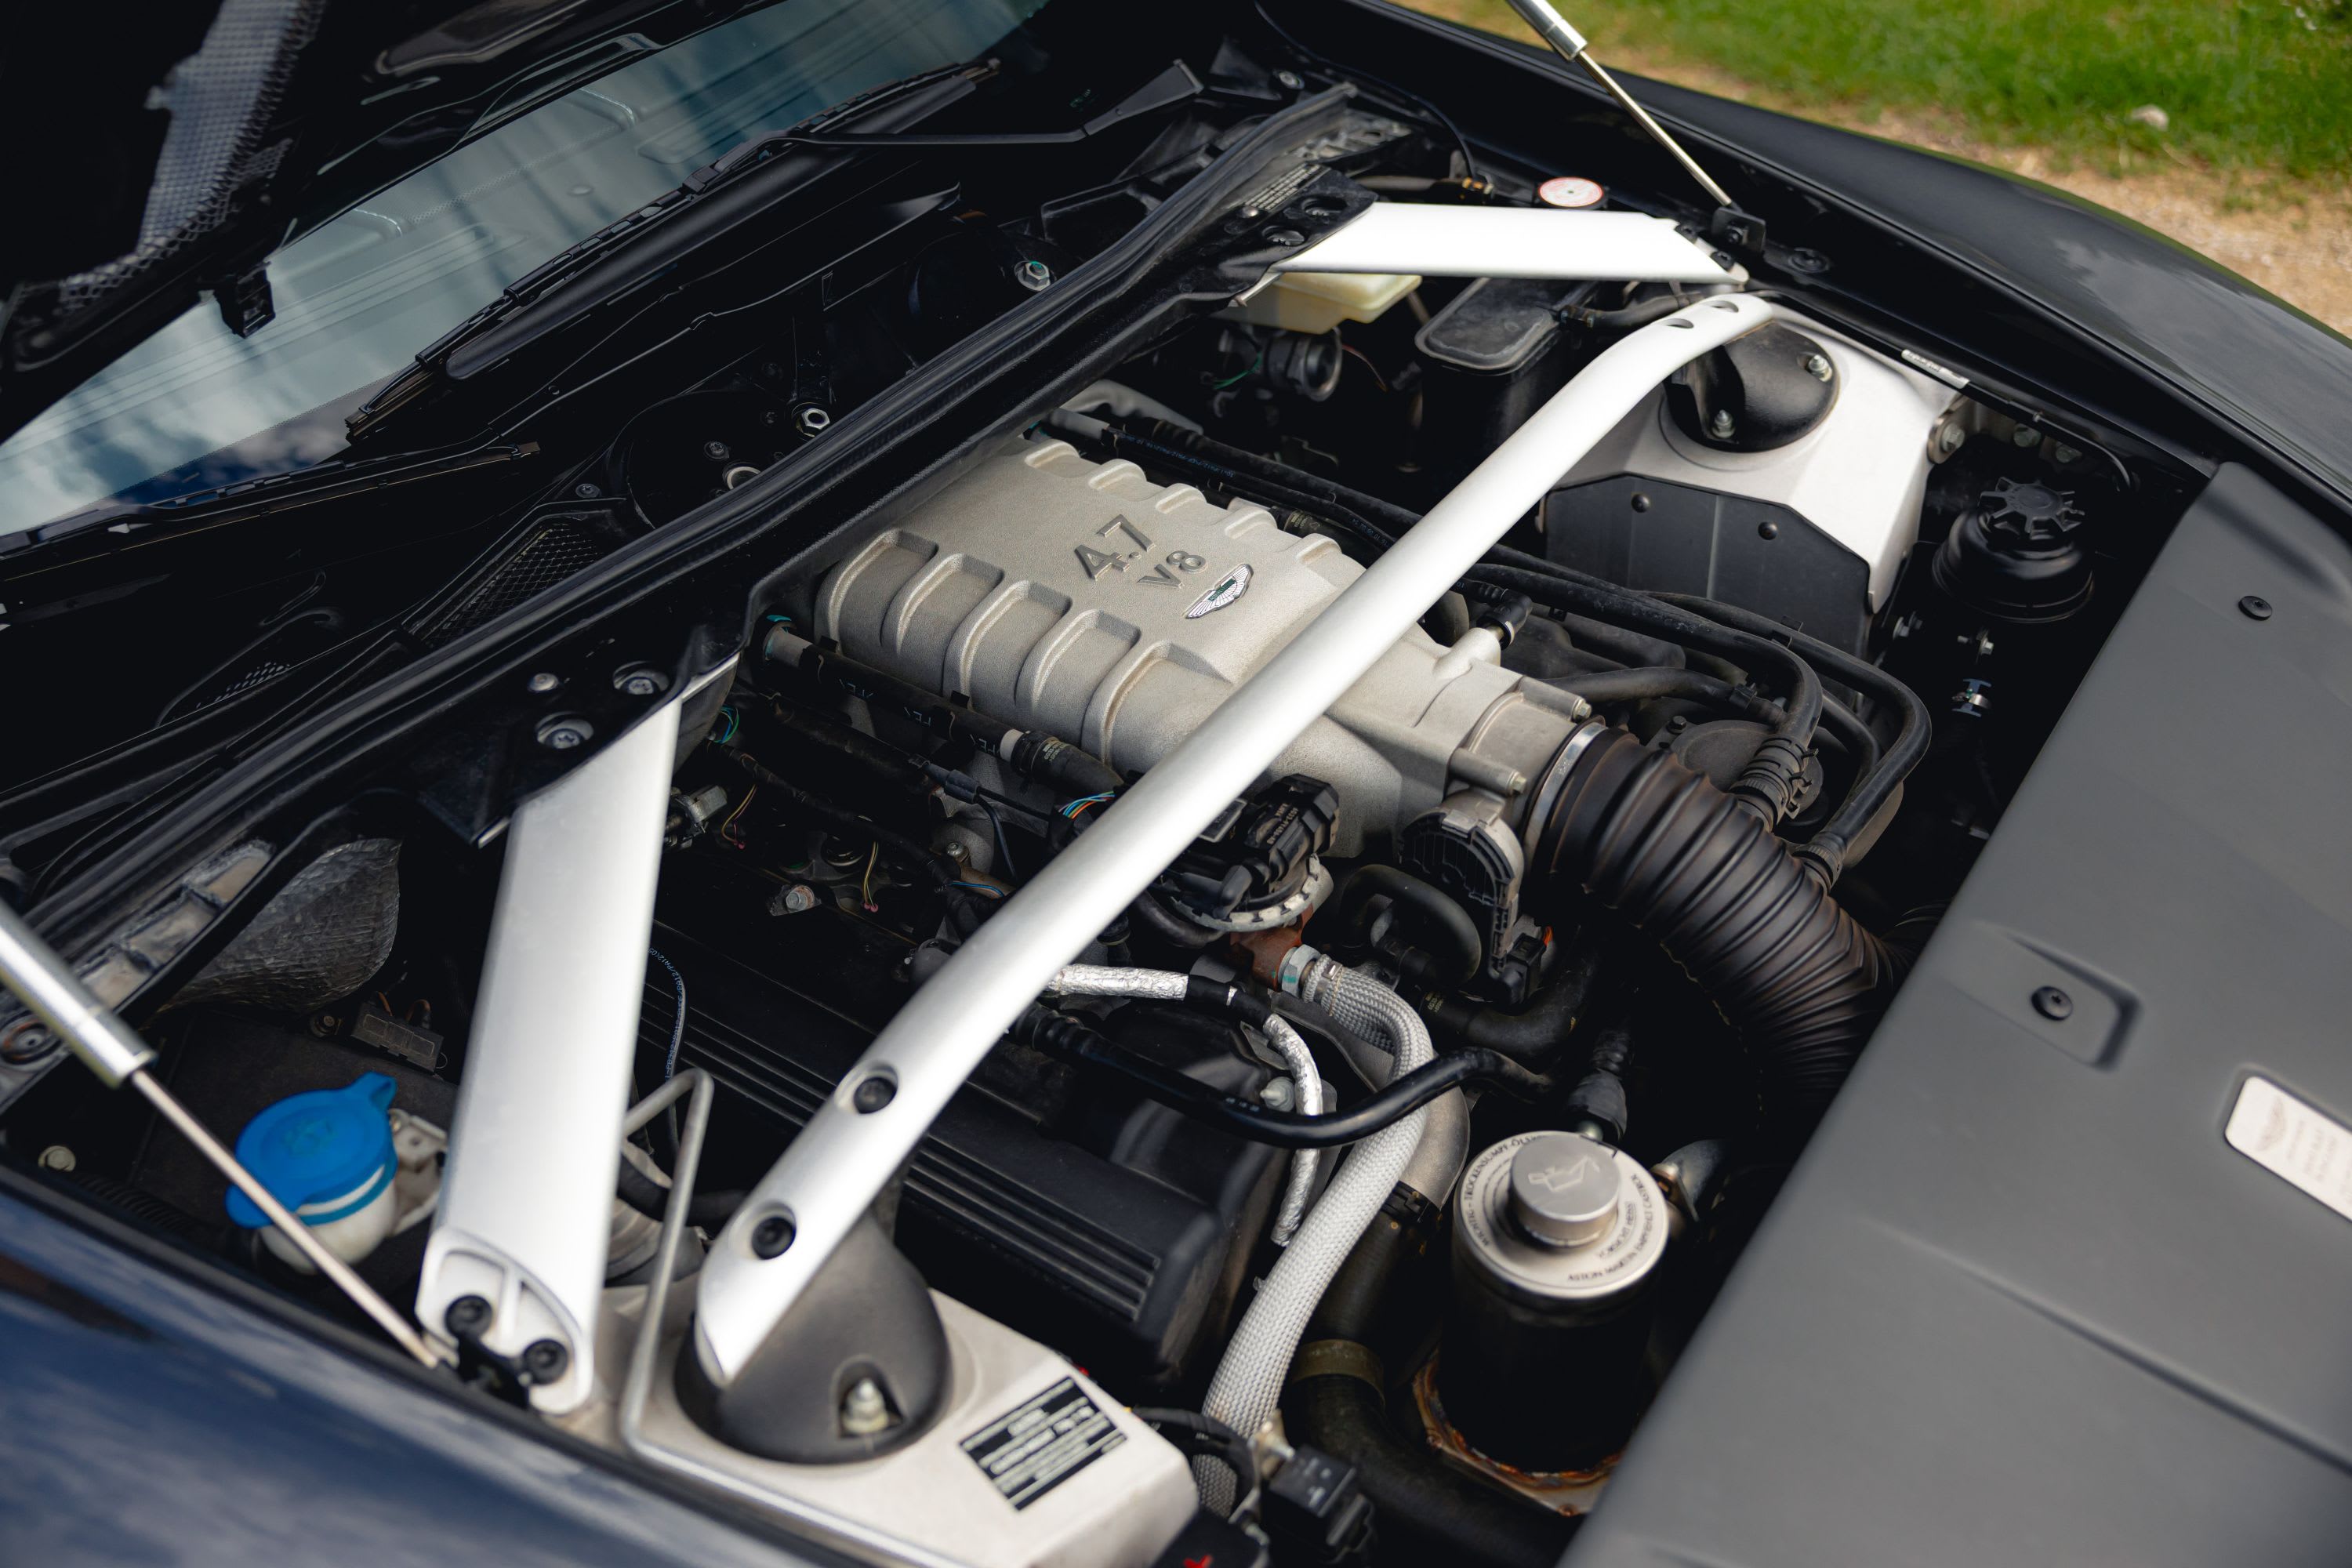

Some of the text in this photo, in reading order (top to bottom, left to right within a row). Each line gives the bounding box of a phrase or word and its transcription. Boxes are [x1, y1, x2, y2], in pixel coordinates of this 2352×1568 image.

[1074, 514, 1156, 581] 4.7
[1138, 550, 1208, 589] V8
[1568, 1271, 1602, 1282] ASTON
